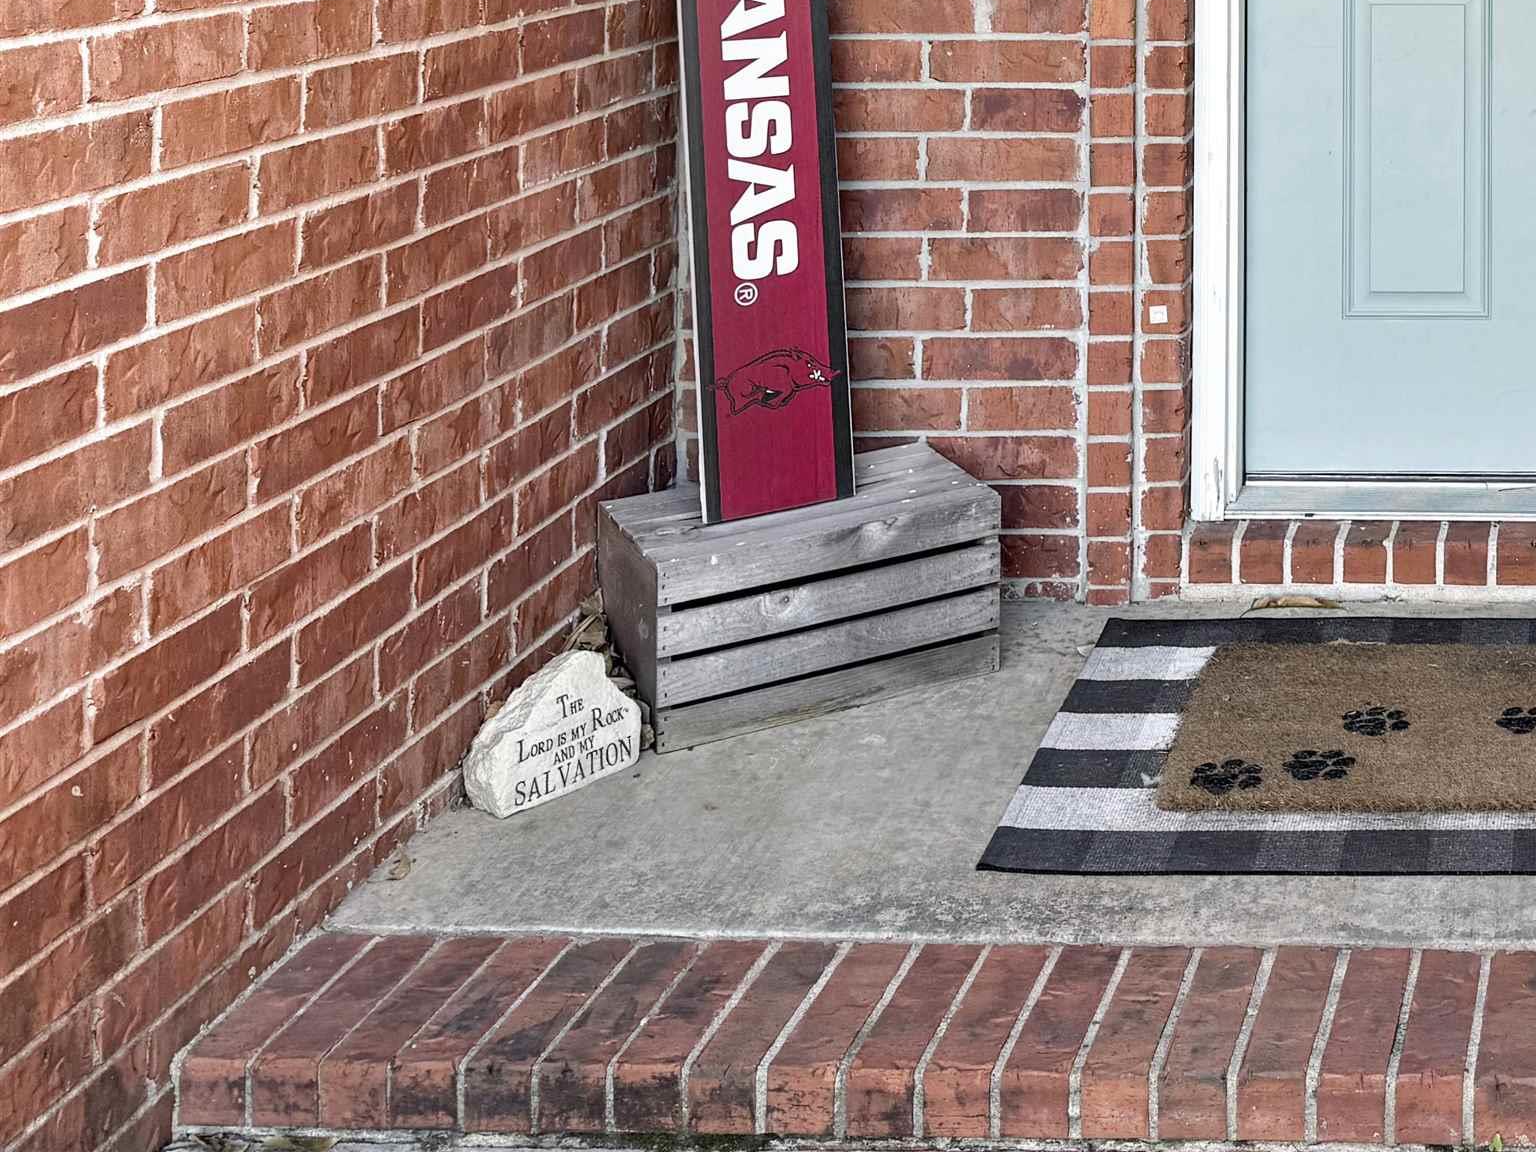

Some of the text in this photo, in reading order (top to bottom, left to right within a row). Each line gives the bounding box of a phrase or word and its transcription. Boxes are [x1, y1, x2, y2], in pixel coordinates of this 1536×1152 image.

[556, 694, 585, 720] THE
[517, 738, 554, 764] LORD
[557, 732, 567, 748] IS
[571, 723, 588, 740] MY
[553, 735, 595, 765] AND MY
[514, 735, 633, 807] SALVATION
